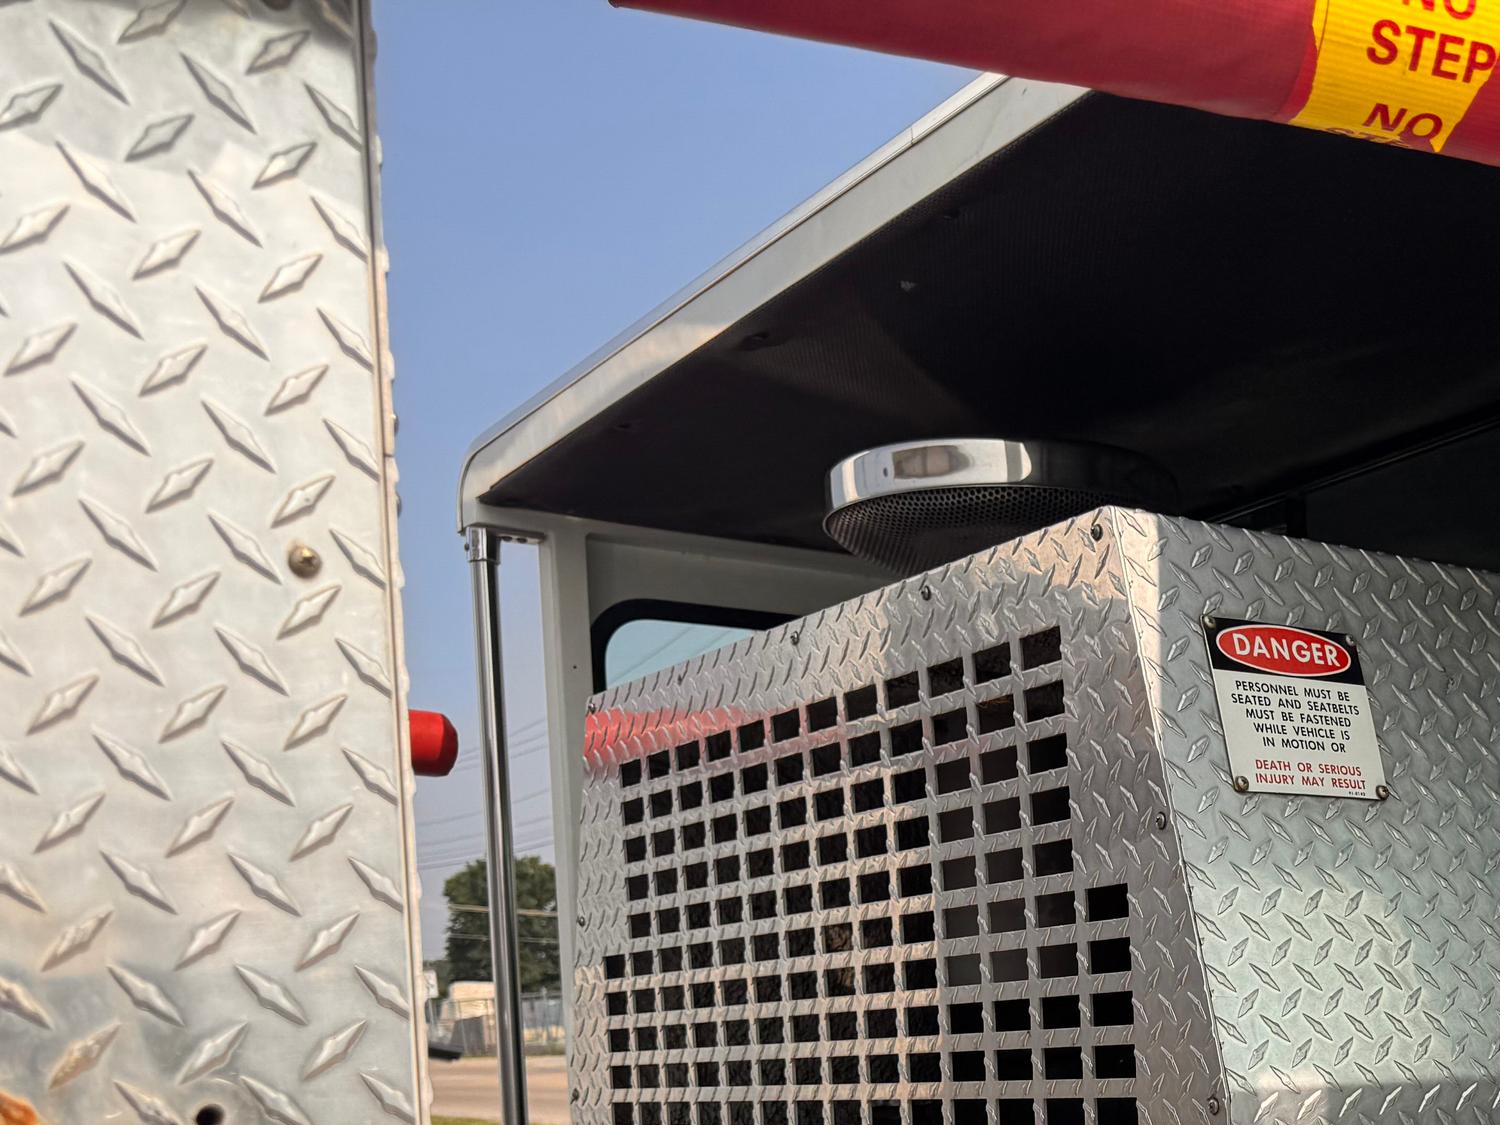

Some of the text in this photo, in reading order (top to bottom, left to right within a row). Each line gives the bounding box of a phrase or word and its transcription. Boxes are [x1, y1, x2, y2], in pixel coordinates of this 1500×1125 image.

[1366, 19, 1497, 83] STEP
[1362, 102, 1443, 140] NO
[1232, 632, 1341, 667] DANGER
[1235, 680, 1351, 702] PERSONNEL MUST BE
[1230, 693, 1360, 716] SEATED AND SEATBELTS
[1245, 708, 1352, 728] MUST BE FASTENED
[1253, 722, 1351, 741] WHILE VEHICLE IS
[1262, 736, 1346, 753] IN MOTION OR
[1255, 759, 1362, 777] DEATH OR SERIOUS
[1255, 773, 1366, 790] INJURY MAY RESULT
